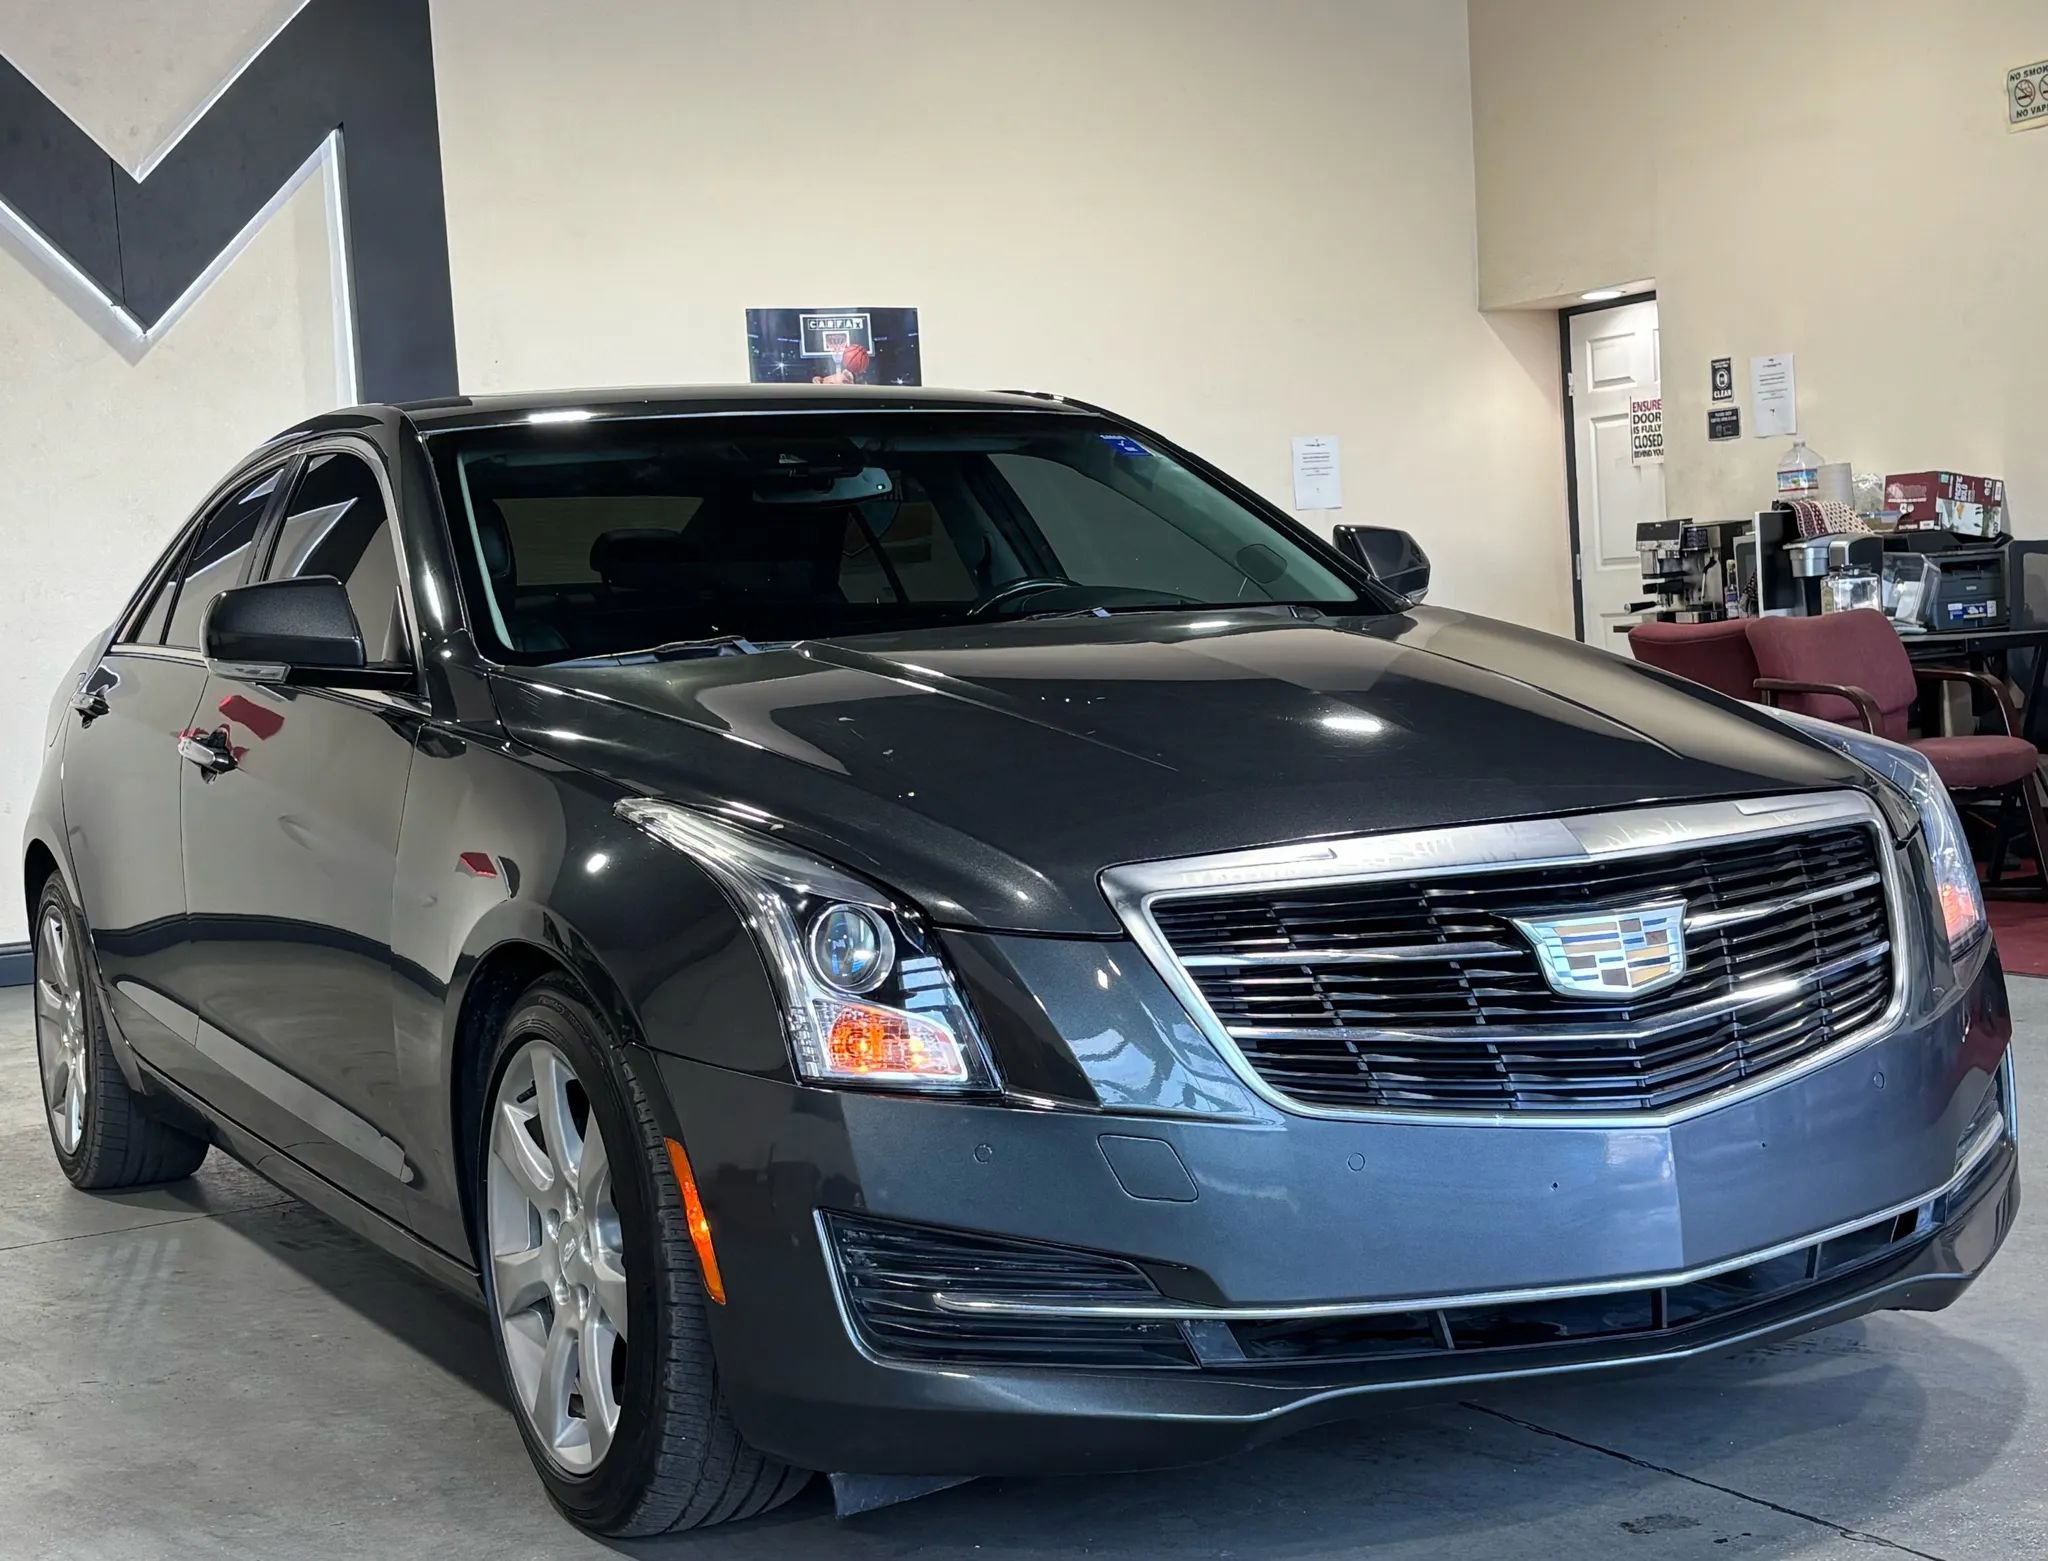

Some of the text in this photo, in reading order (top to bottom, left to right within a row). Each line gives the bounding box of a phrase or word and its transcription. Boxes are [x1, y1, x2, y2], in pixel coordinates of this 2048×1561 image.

[2010, 72, 2021, 81] NO
[2016, 109, 2028, 118] NO
[808, 319, 863, 329] CARFAX
[1632, 399, 1662, 413] ENSURE
[1633, 412, 1662, 425] DOOR
[1633, 424, 1662, 435] IS FULLY
[1633, 433, 1663, 449] CLOSED
[1634, 448, 1664, 458] BEHIND YOU
